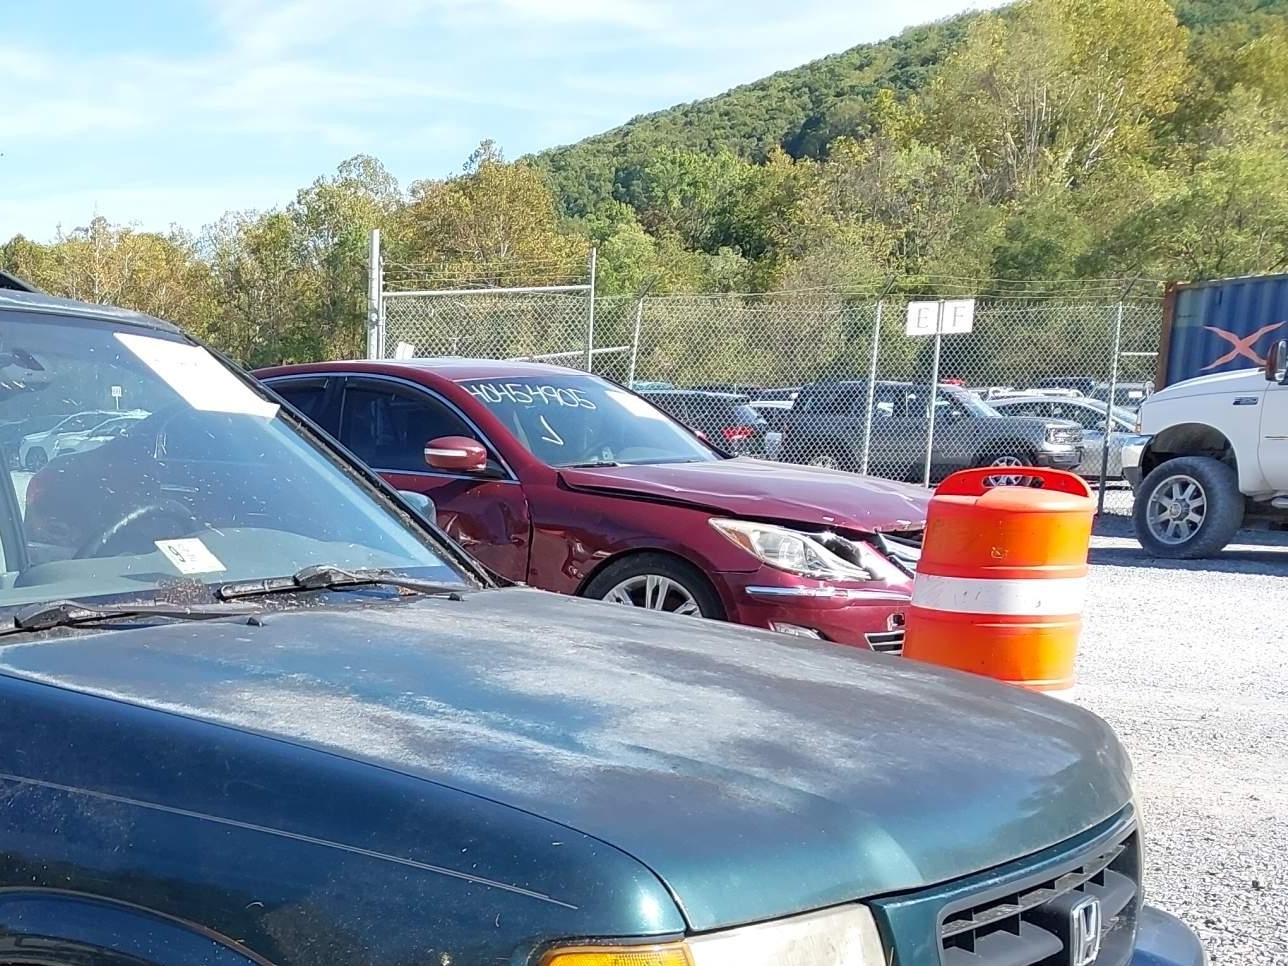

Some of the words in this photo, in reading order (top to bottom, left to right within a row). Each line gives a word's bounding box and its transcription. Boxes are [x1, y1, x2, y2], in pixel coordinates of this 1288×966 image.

[916, 307, 930, 329] E
[952, 306, 966, 328] F
[460, 383, 597, 410] 40454905
